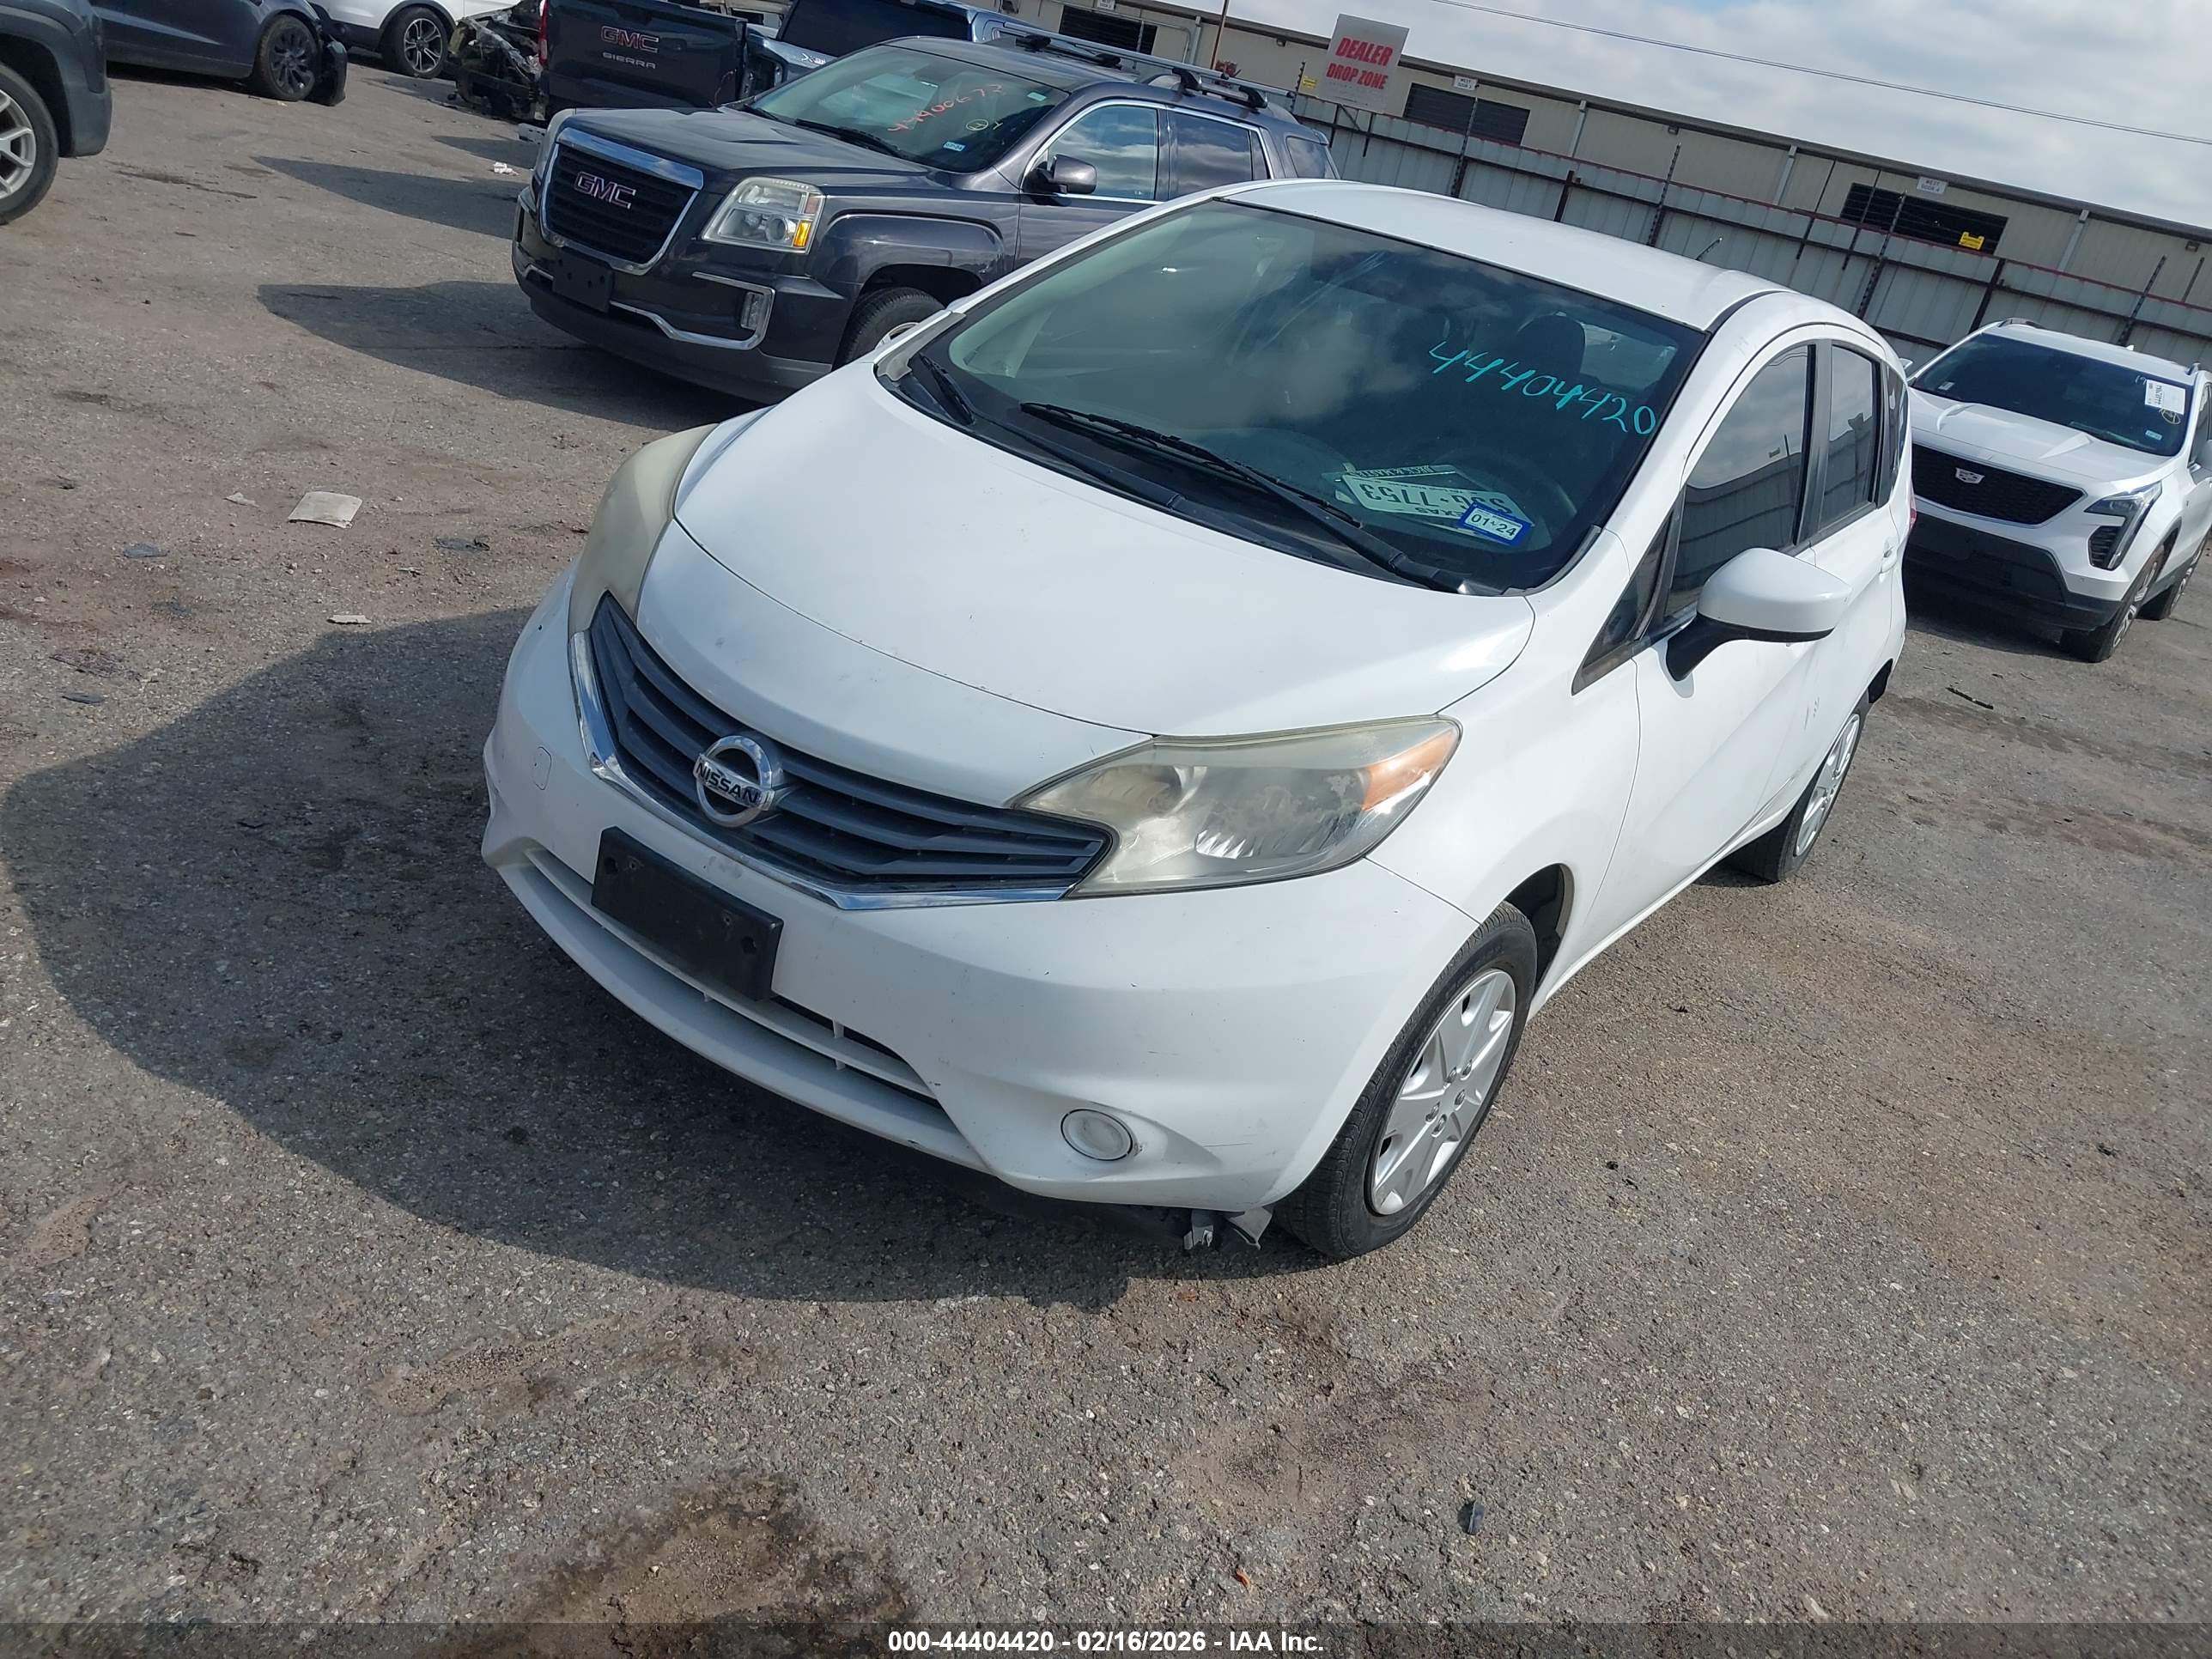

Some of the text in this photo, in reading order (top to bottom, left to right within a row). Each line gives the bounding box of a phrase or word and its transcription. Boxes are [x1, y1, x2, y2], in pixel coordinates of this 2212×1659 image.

[601, 26, 659, 53] GMC
[1335, 37, 1394, 66] DEALER
[602, 52, 656, 70] SIERRA
[1326, 63, 1358, 82] DROP
[1358, 69, 1389, 90] ZONE
[574, 171, 636, 210] GMC
[1428, 341, 1656, 434] 44404420
[696, 762, 760, 804] NISSAN
